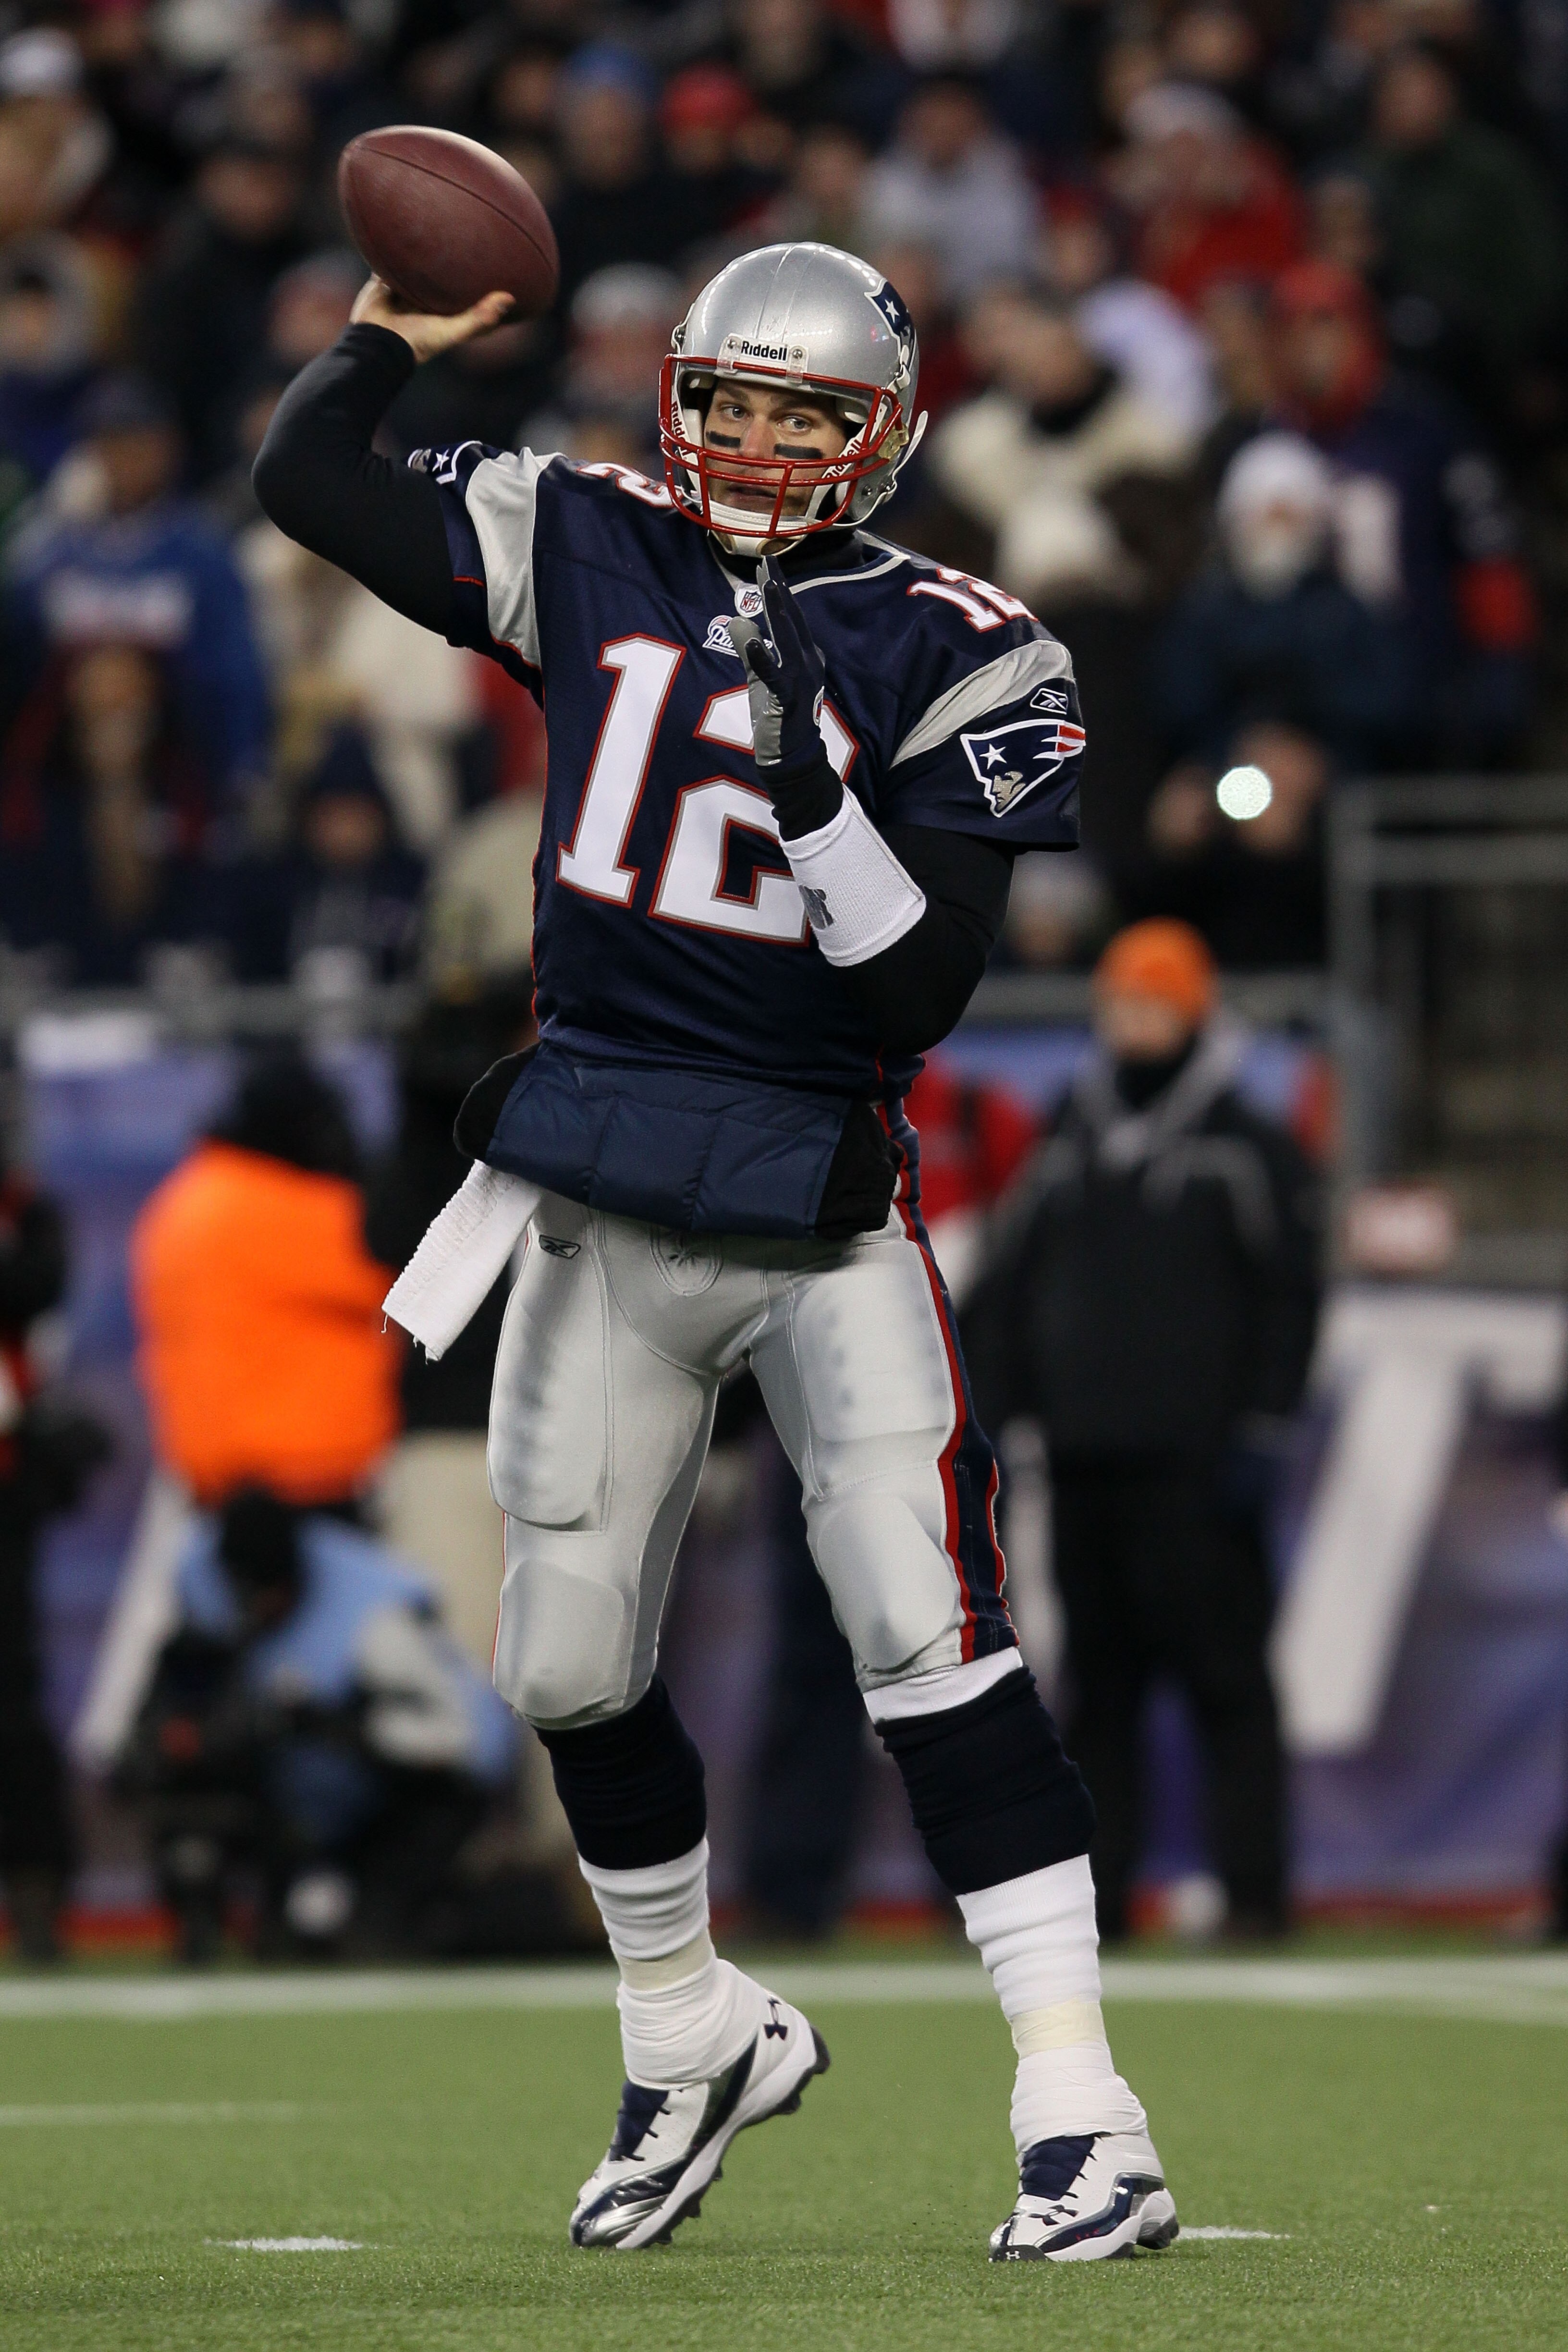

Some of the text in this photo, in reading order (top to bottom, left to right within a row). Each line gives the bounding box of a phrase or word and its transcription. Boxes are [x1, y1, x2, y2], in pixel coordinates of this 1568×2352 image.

[741, 341, 787, 361] Riddell
[741, 599, 757, 611] NFL
[906, 566, 1039, 633] 12
[556, 632, 860, 948] 12
